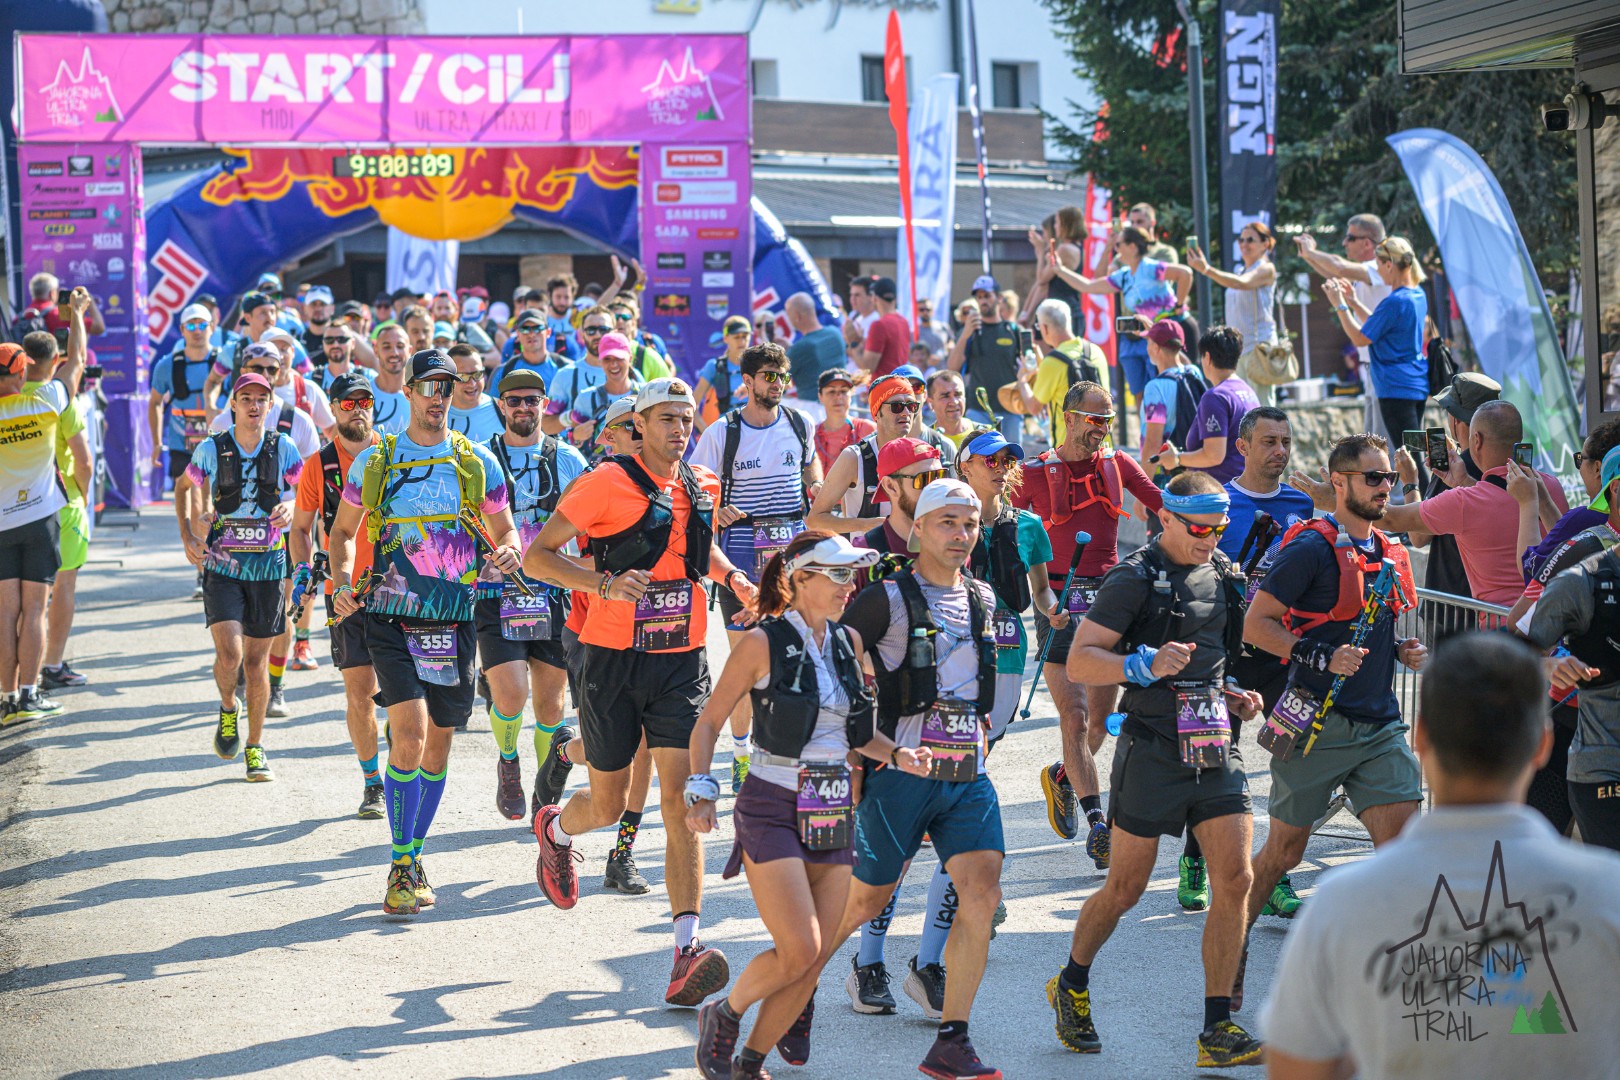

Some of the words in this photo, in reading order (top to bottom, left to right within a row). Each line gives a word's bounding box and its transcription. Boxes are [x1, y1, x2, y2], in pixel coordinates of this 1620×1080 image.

[1225, 10, 1266, 155] NGN
[261, 108, 294, 130] MIDI
[414, 108, 471, 132] ULTRA
[350, 154, 452, 178] 9:00:09
[914, 121, 942, 280] SARA
[665, 209, 727, 220] SAMSUNG
[655, 225, 689, 237] SARA
[195, 421, 207, 432] 41
[735, 457, 761, 471] ŠABIĆ
[236, 527, 266, 540] 390
[769, 527, 793, 540] 381
[516, 596, 546, 608] 325
[654, 591, 689, 609] 368
[994, 621, 1016, 637] 19
[420, 634, 453, 649] 355
[1281, 691, 1314, 721] 393
[946, 715, 976, 734] 345
[818, 779, 849, 799] 409
[1401, 941, 1531, 976] JAHORINA
[1402, 975, 1496, 1010] ULTRA
[1402, 1009, 1488, 1041] TRAIL
